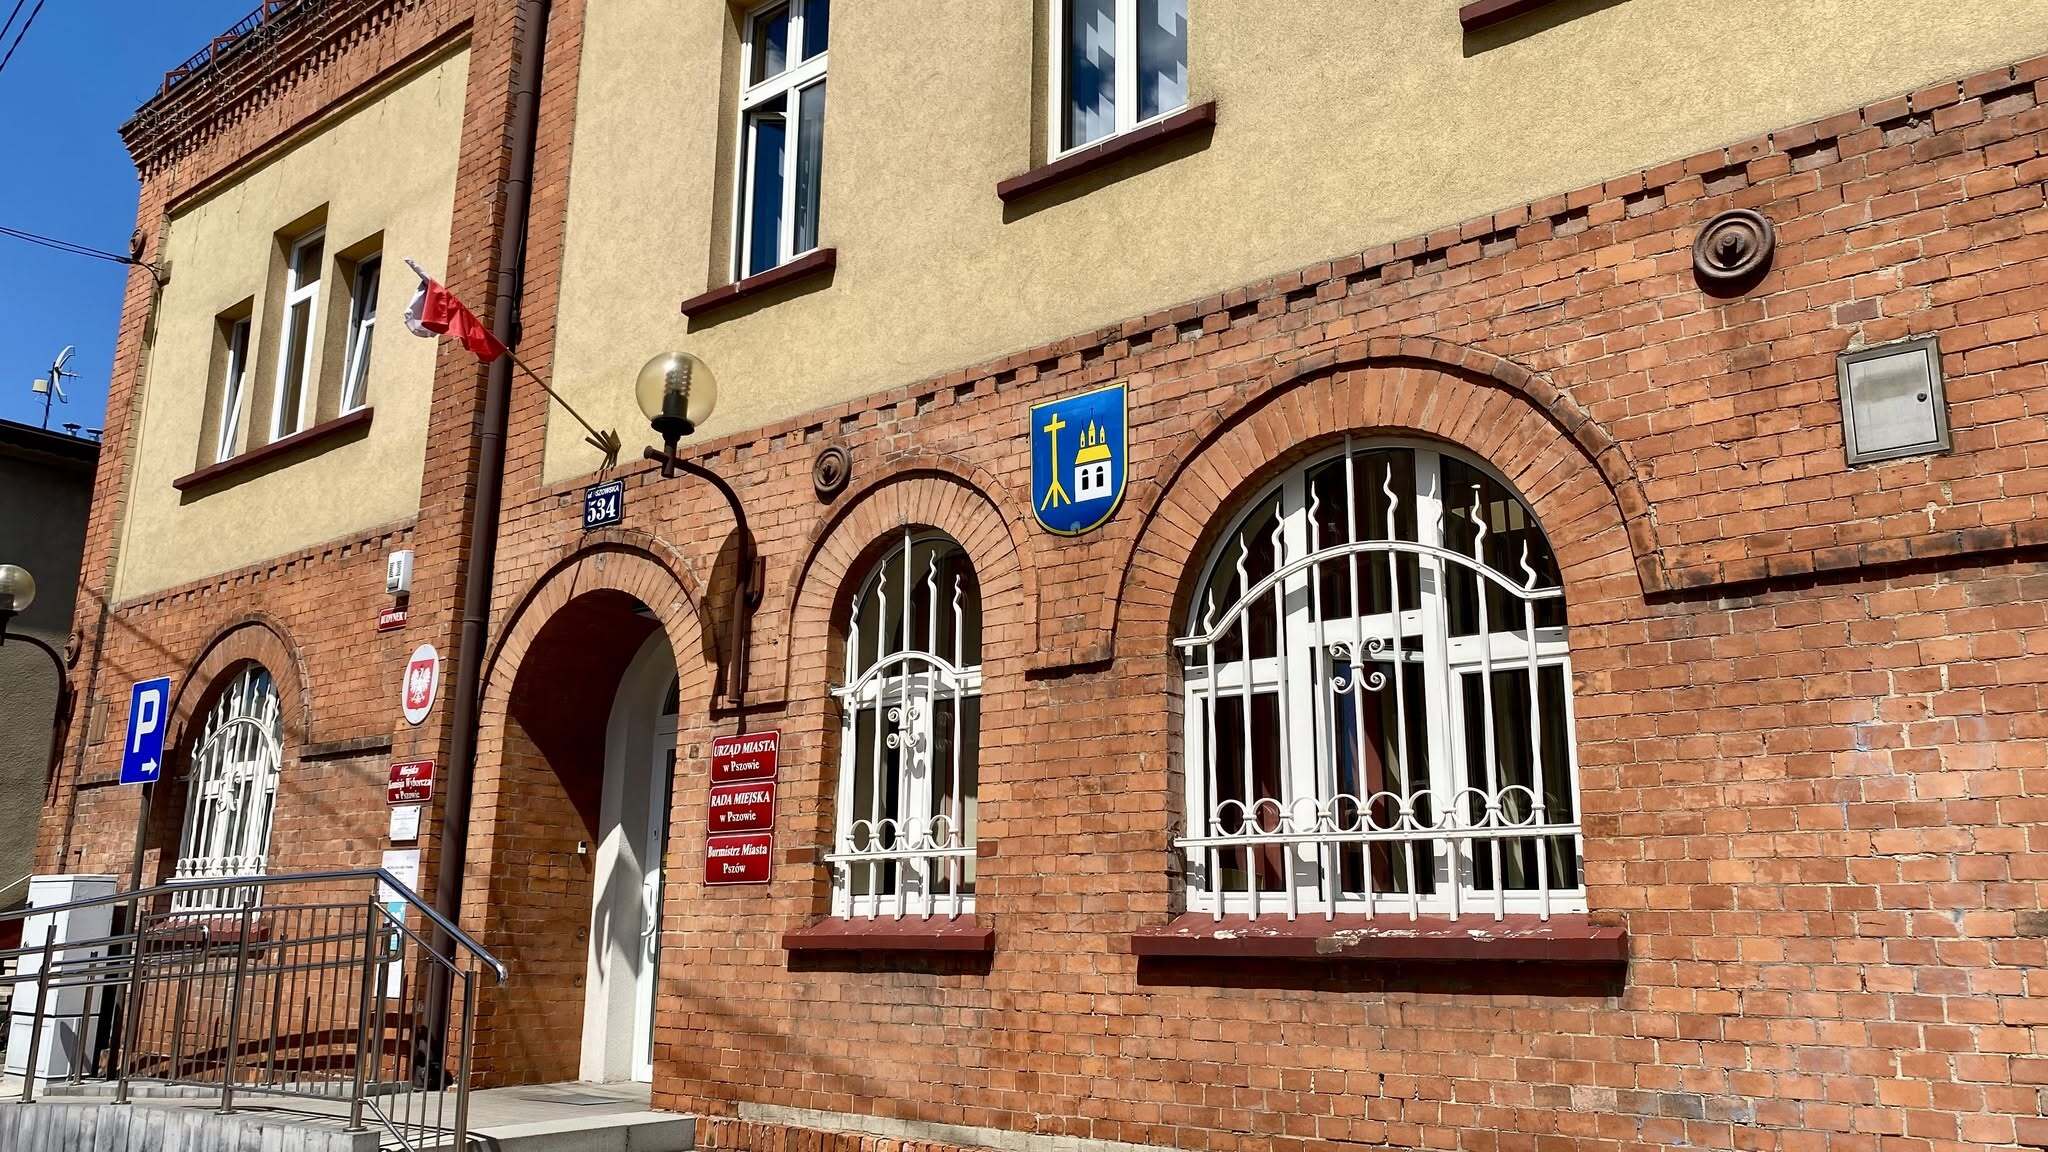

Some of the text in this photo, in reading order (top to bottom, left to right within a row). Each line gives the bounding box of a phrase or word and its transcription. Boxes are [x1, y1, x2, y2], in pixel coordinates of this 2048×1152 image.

[587, 495, 615, 522] 534
[133, 689, 160, 753] P
[714, 740, 776, 758] URZĄD MIASTA
[723, 759, 760, 773] w Pszowie
[711, 791, 771, 807] RADA MIEJSKA
[719, 810, 757, 822] w Pszowie
[708, 844, 768, 858] Burmistrz Miasta
[723, 862, 746, 874] Pszów
